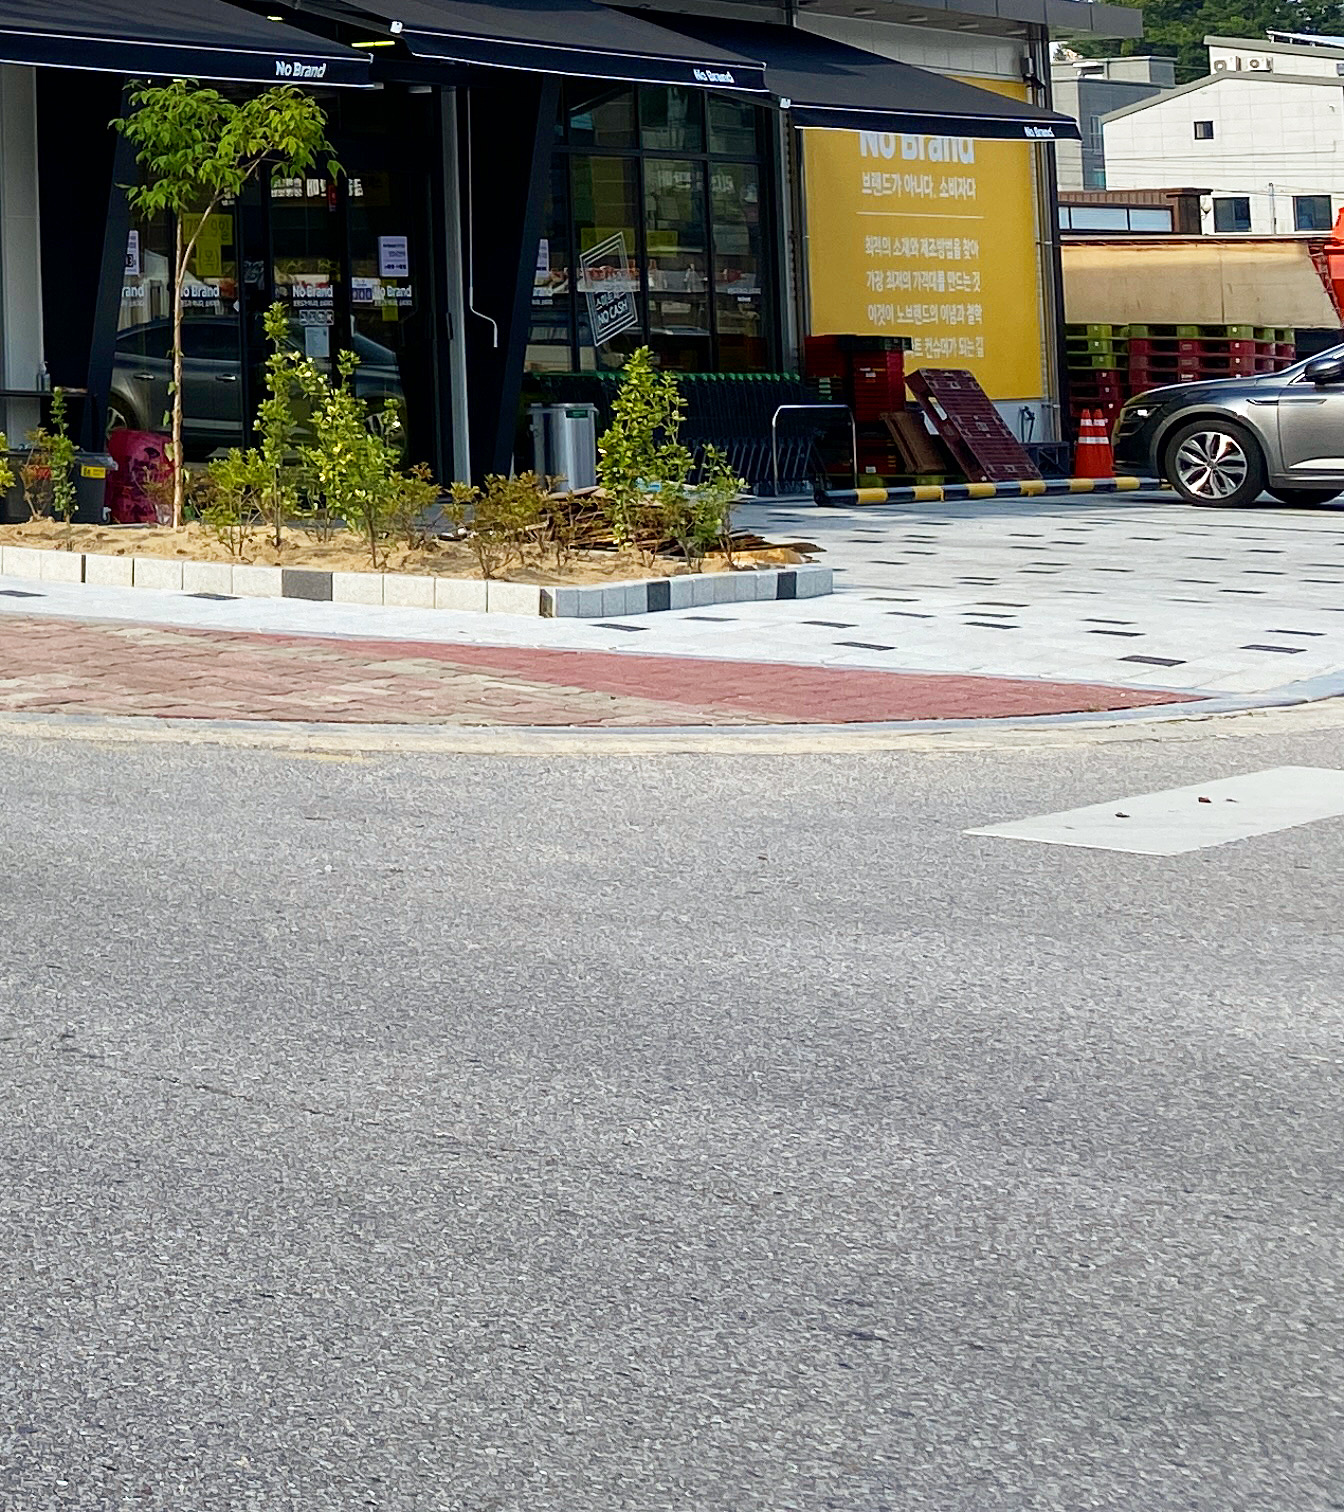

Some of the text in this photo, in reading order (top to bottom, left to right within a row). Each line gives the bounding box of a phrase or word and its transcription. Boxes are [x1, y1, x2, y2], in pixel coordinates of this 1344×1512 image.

[275, 60, 327, 78] No Brand
[862, 172, 902, 198] 브랜드가
[939, 176, 977, 201] 소비자다
[122, 285, 144, 298] rand
[598, 311, 608, 326] NO
[609, 300, 628, 322] CASH
[868, 303, 894, 327] 이것이
